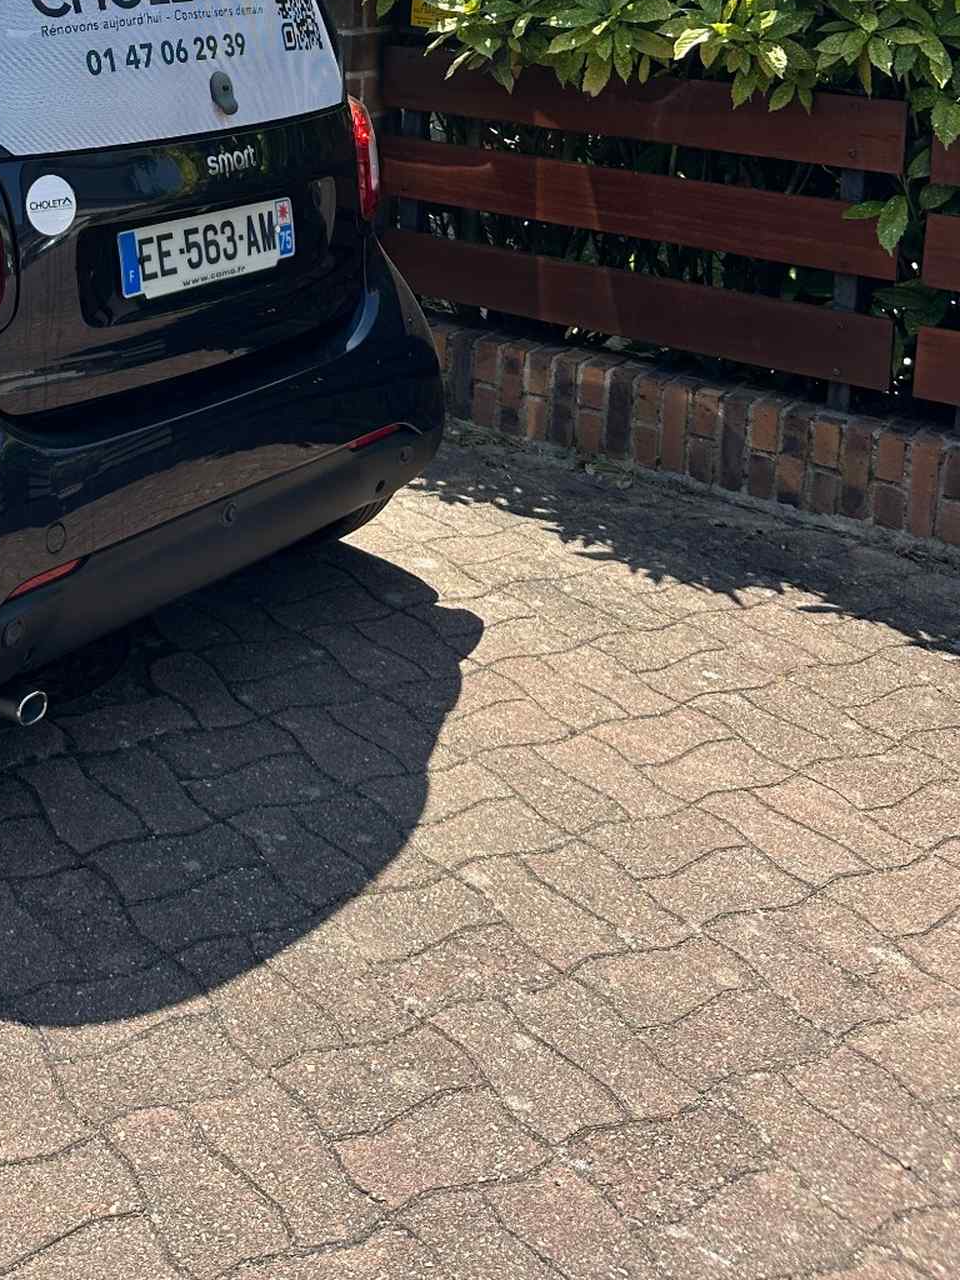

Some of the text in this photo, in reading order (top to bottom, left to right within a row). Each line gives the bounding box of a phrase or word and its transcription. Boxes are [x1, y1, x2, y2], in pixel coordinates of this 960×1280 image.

[41, 21, 100, 38] Rénovons
[103, 13, 162, 32] aujourd'hui
[174, 6, 234, 21] Construisons
[86, 32, 246, 76] 01 47 06 29 39
[207, 145, 257, 176] smart
[29, 199, 65, 211] CHOLET
[138, 210, 277, 282] EE-563-AM
[279, 229, 292, 253] 75
[129, 270, 135, 284] F
